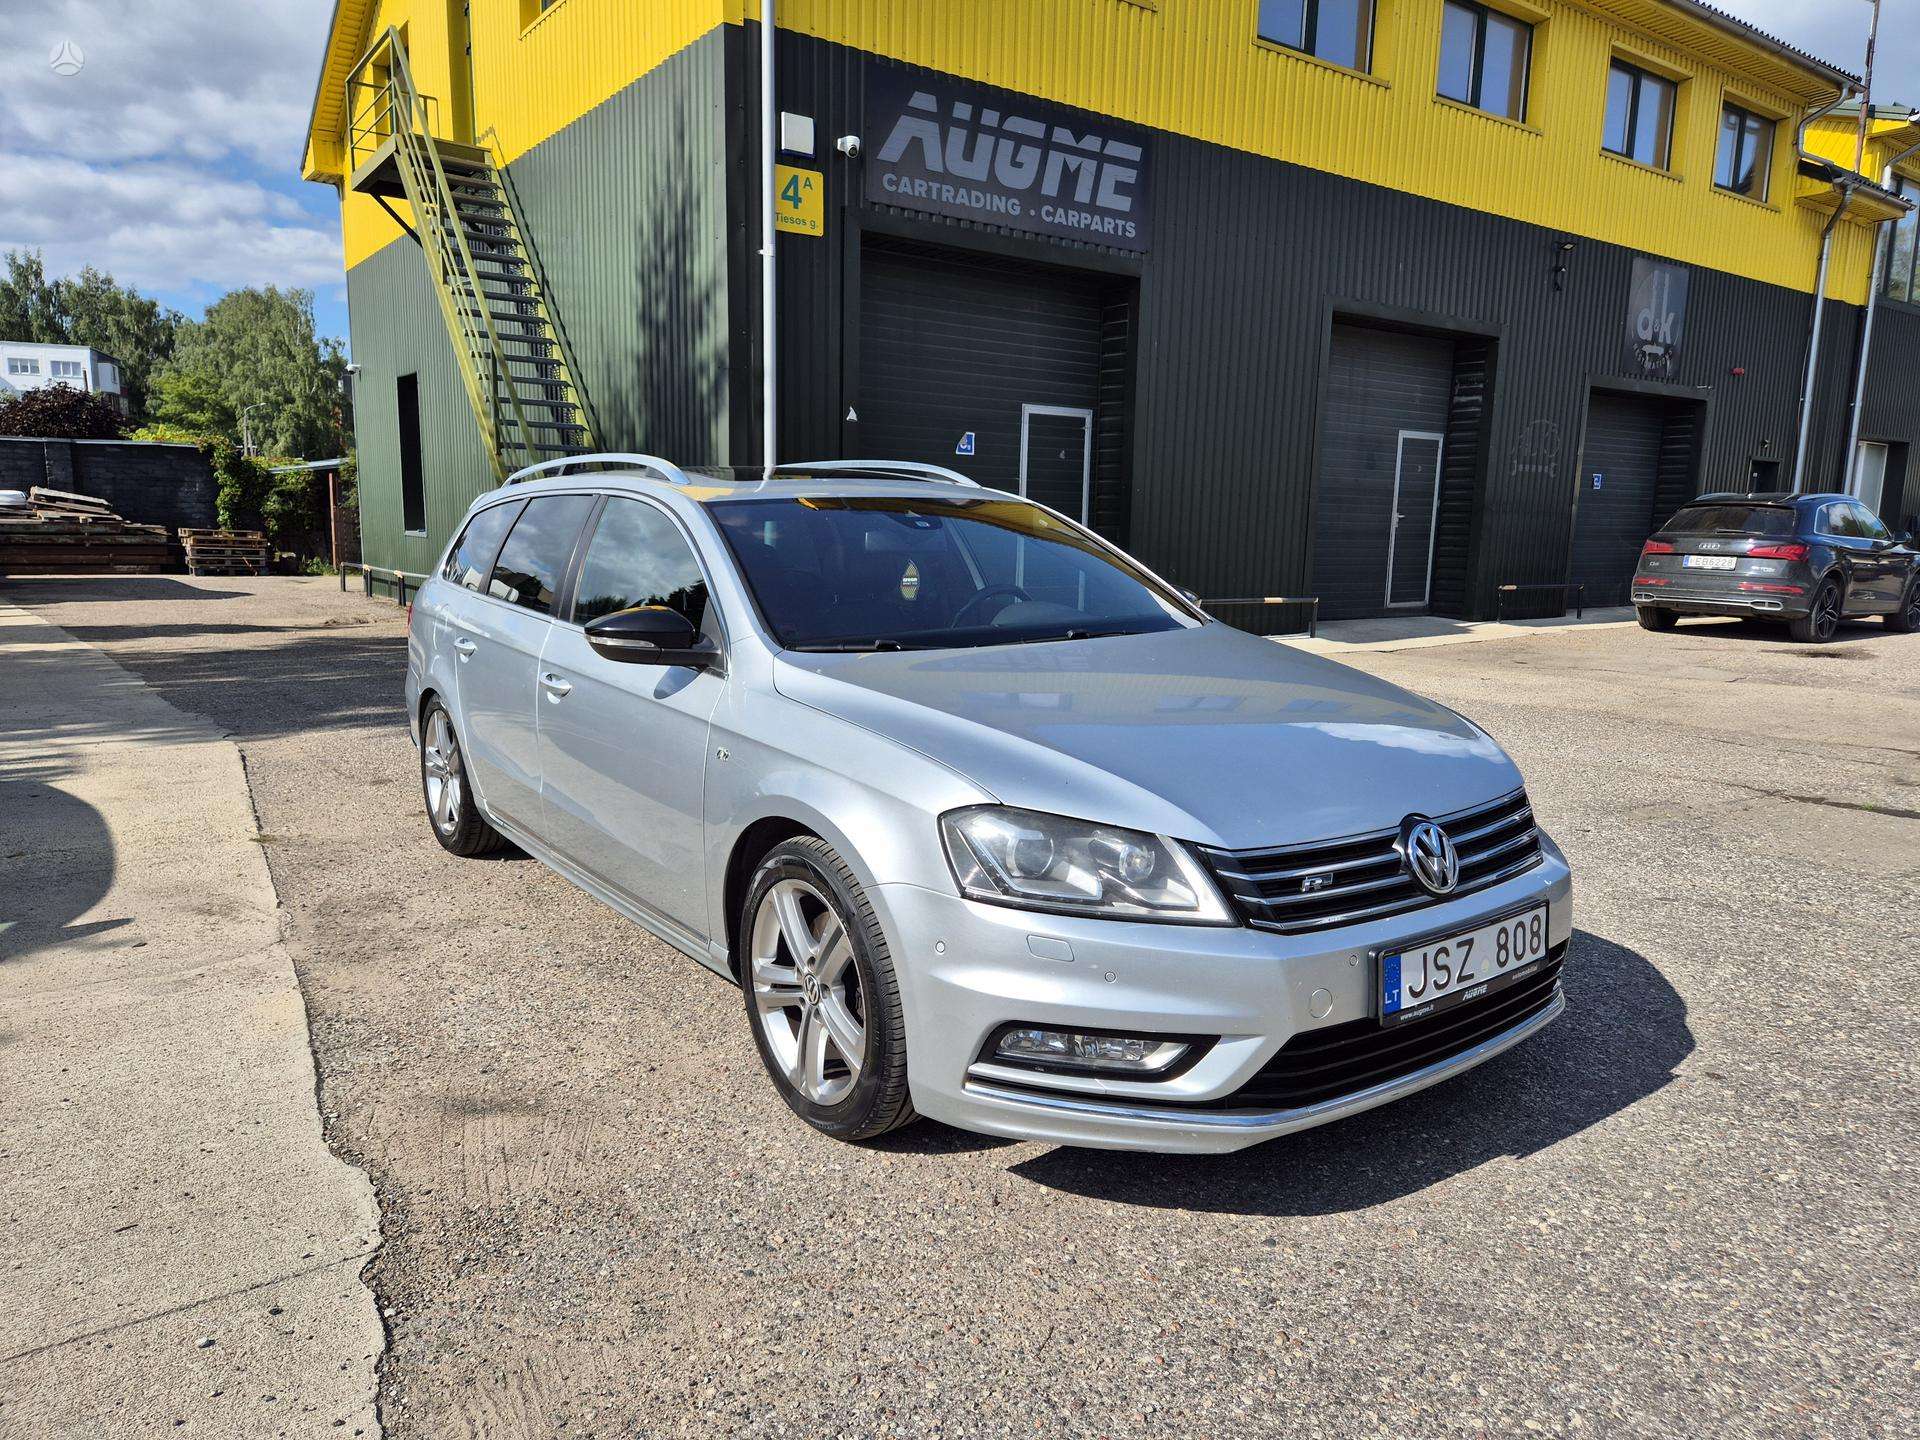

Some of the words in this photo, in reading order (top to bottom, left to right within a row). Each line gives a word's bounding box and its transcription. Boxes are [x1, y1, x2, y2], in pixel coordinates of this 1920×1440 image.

[882, 173, 1021, 216] CARTRADING
[1041, 205, 1136, 238] CARPARTS
[1385, 989, 1399, 1004] LT
[1408, 937, 1475, 998] JSZ
[1496, 914, 1541, 968] 808
